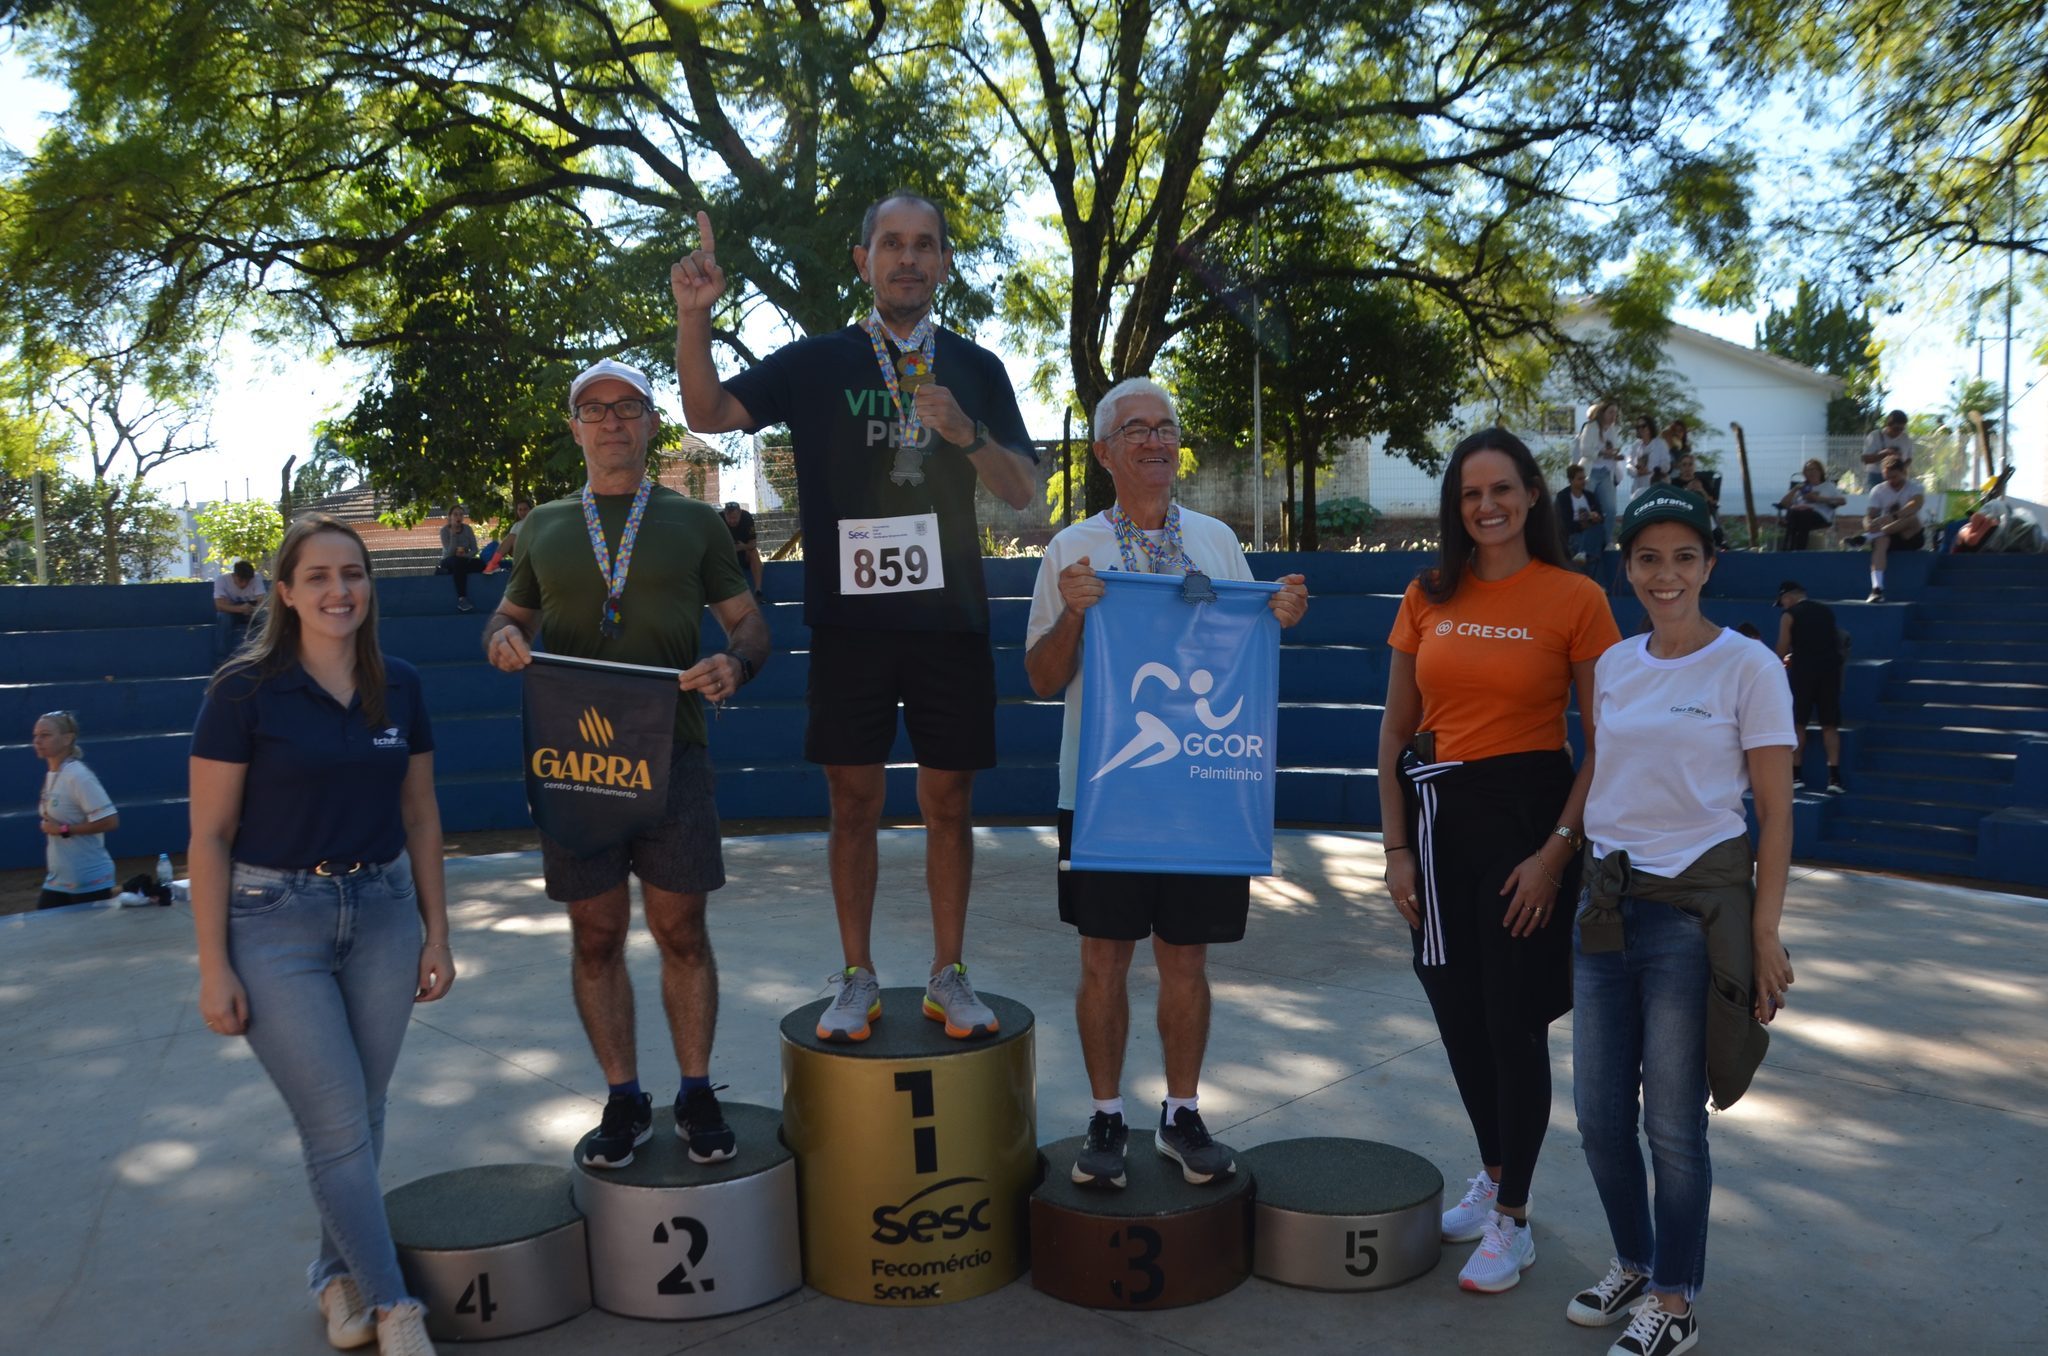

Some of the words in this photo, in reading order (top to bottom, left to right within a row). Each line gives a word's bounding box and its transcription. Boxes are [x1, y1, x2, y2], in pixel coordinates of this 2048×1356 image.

[1634, 500, 1655, 515] Casa
[854, 545, 929, 588] 859
[1456, 622, 1534, 641] CRESOL
[1183, 733, 1263, 758] GCOR
[532, 748, 652, 790] GARRA
[1190, 765, 1263, 781] Palmitinho
[544, 782, 572, 791] centro
[573, 784, 585, 792] de
[585, 785, 638, 799] treinamento
[894, 1069, 938, 1174] 1
[653, 1216, 715, 1295] 2
[871, 1249, 993, 1277] Fecomércio
[1109, 1225, 1165, 1303] 3
[1345, 1229, 1379, 1277] 5
[455, 1273, 498, 1322] 4
[874, 1282, 941, 1299] Senac
